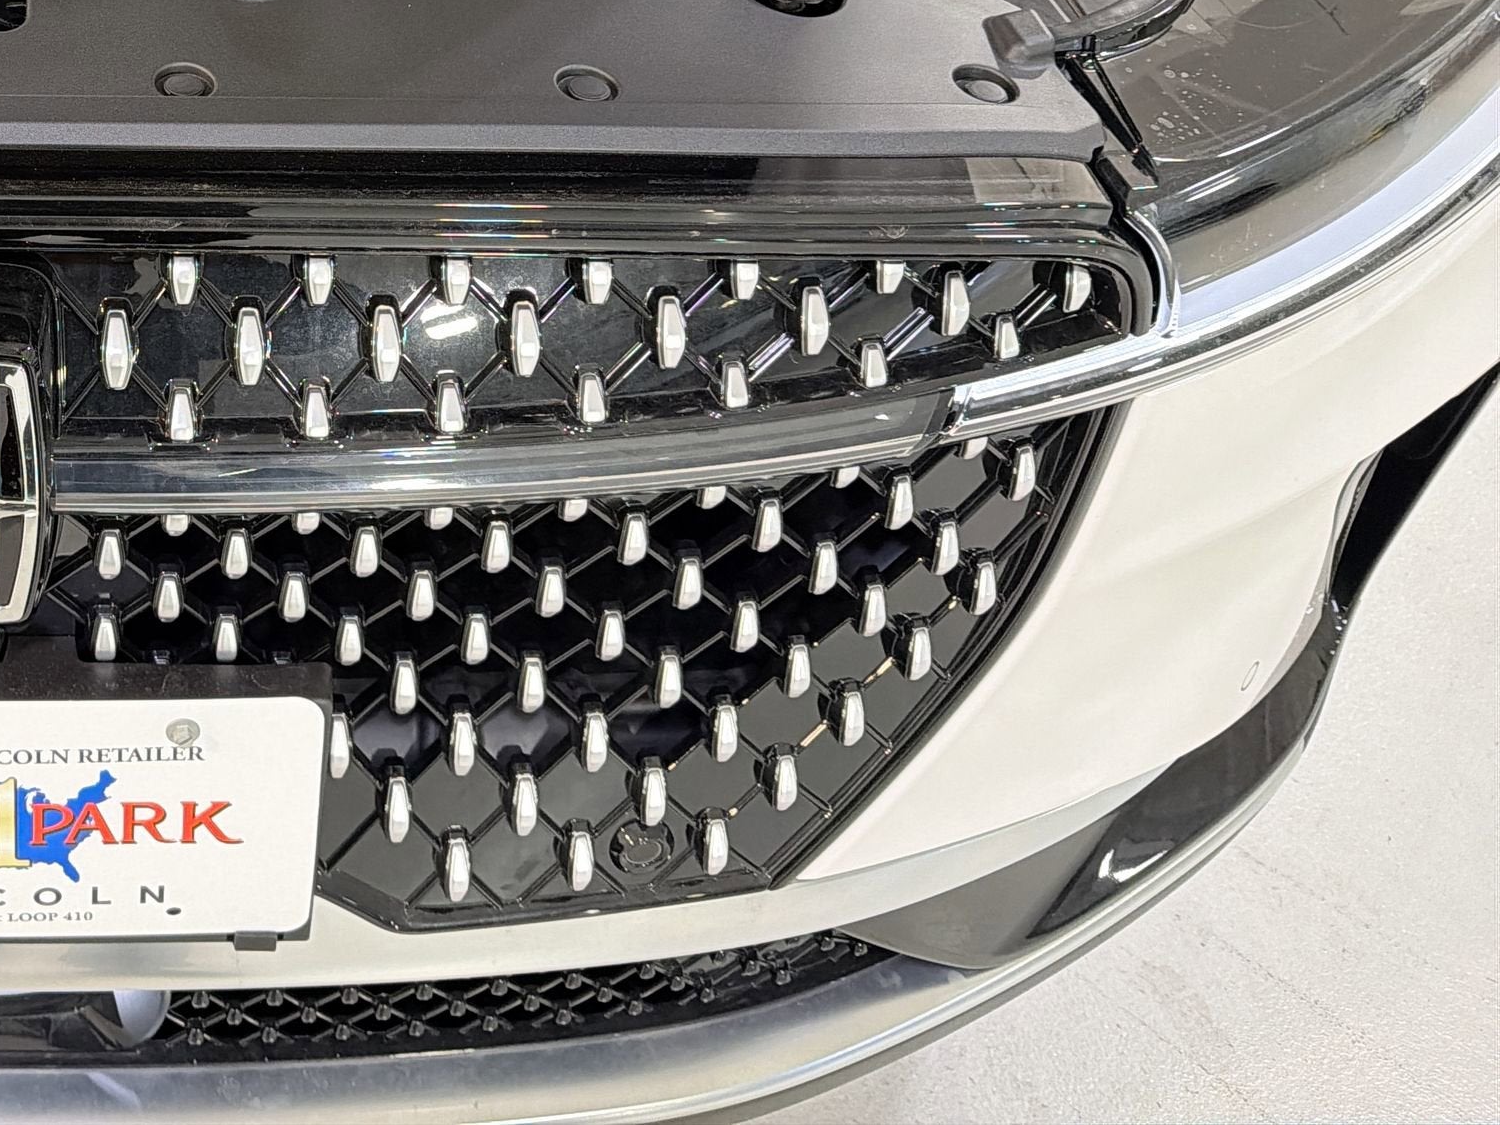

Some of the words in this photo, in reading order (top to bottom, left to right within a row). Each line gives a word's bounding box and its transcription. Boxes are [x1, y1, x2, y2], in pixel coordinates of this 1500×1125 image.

[77, 745, 206, 764] RETAILER
[29, 801, 244, 846] PARK
[6, 912, 60, 922] LOOP
[62, 911, 94, 922] 410
